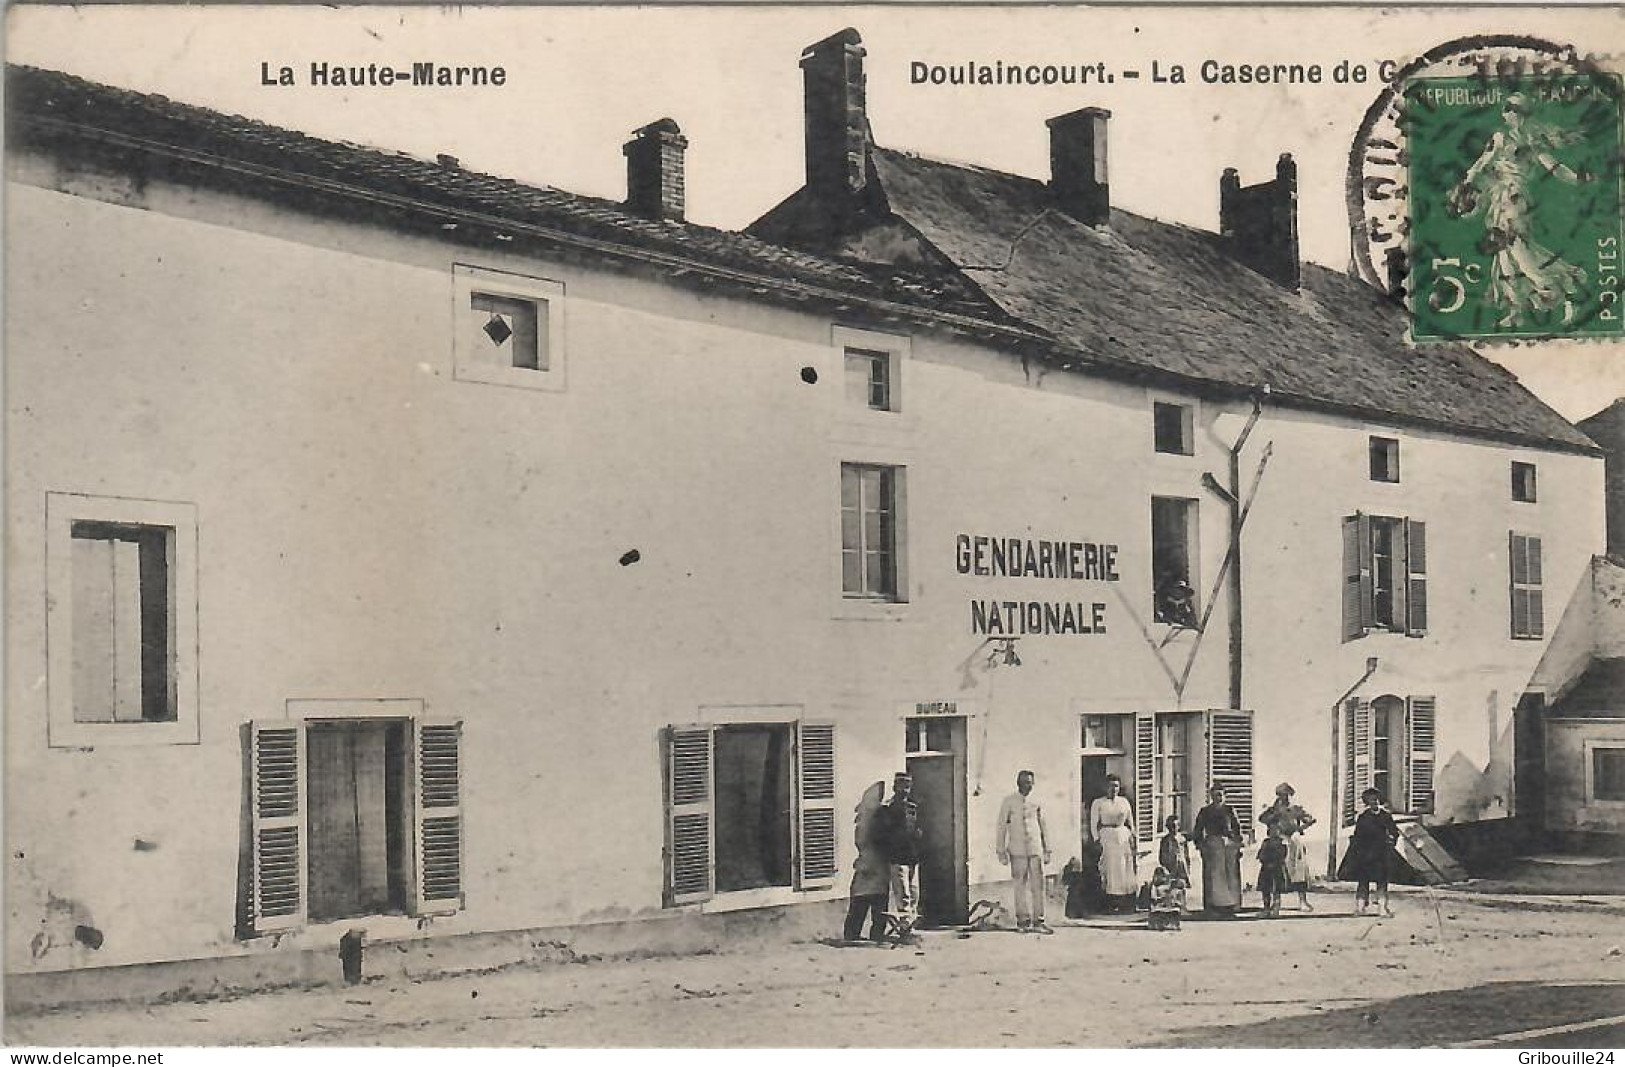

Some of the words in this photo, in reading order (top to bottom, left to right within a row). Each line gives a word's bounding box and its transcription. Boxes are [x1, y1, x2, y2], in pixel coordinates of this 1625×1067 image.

[1598, 236, 1617, 321] POSTES
[956, 533, 1120, 582] GENDARMERIE
[971, 599, 1107, 635] NATIONALE
[915, 702, 957, 714] BUREAU
